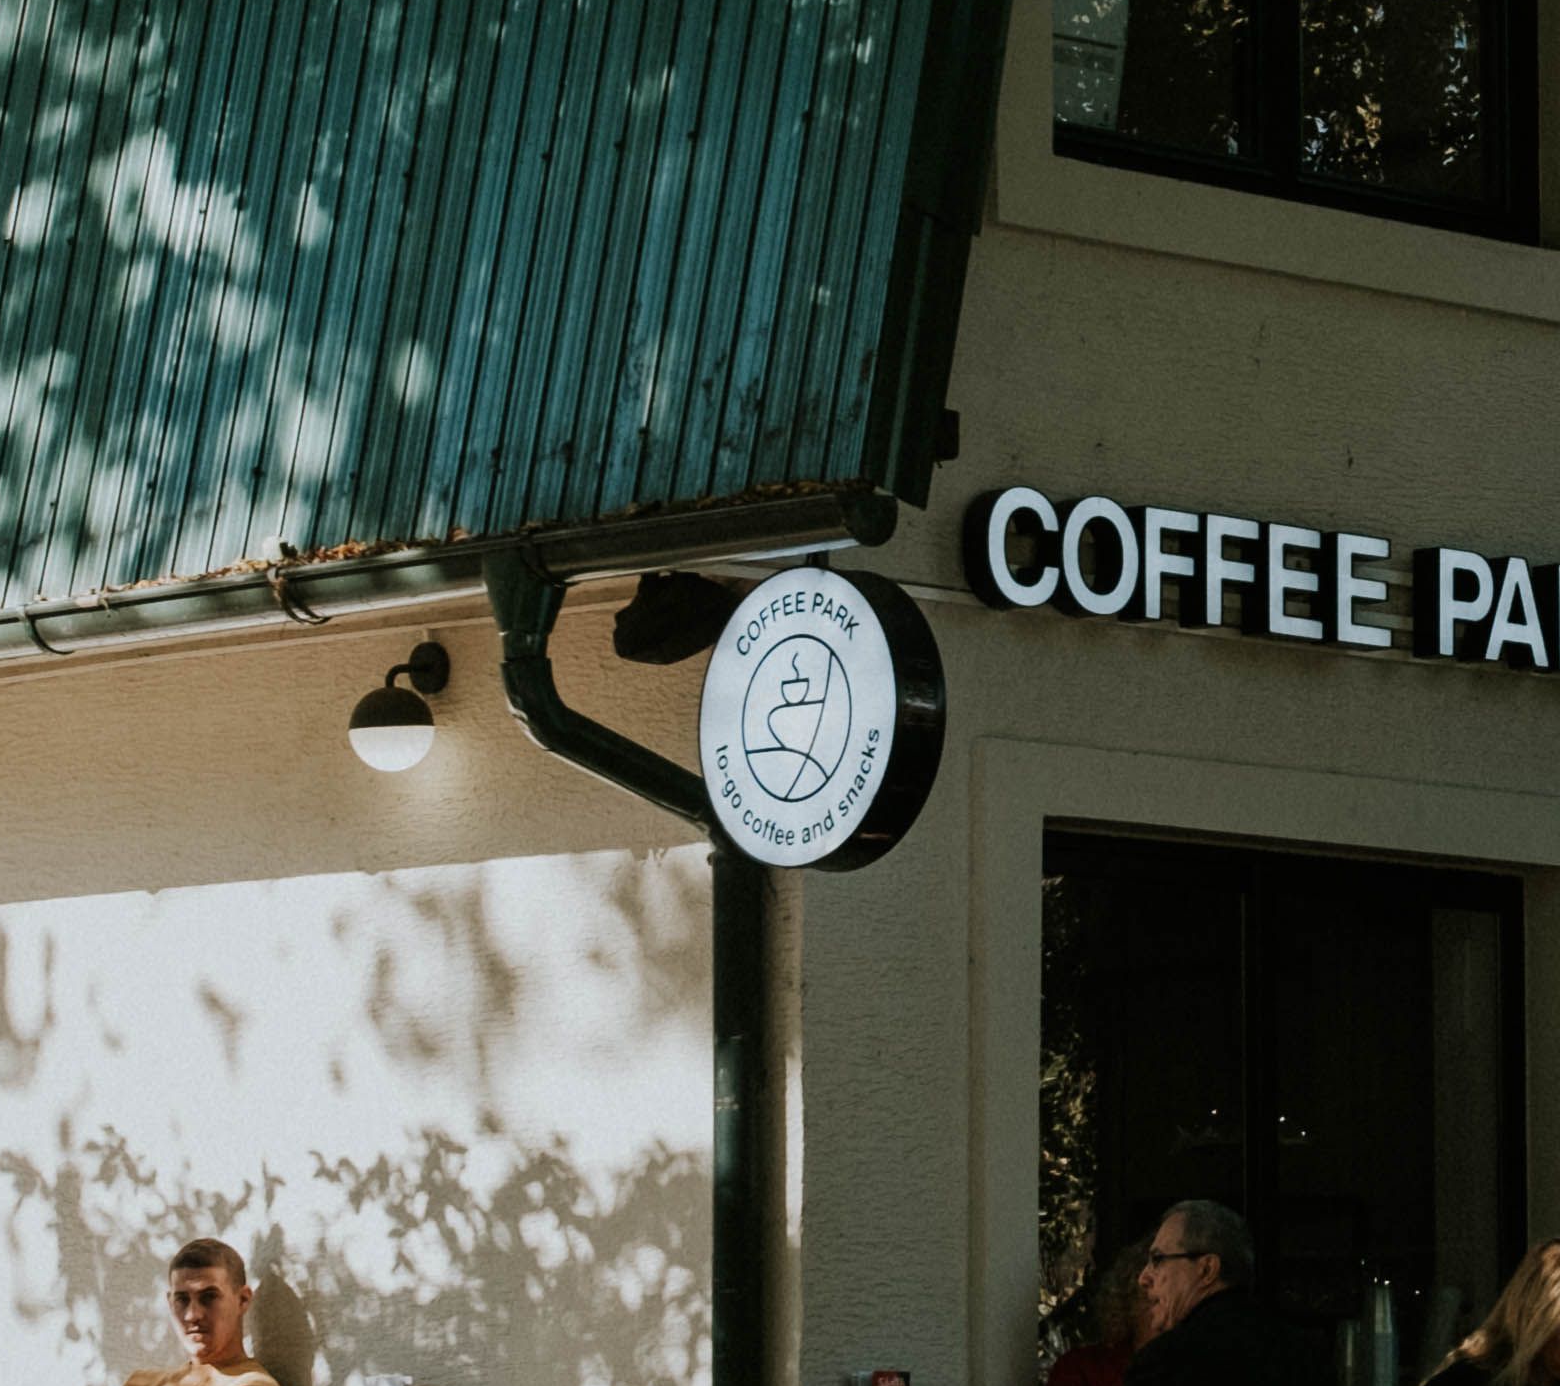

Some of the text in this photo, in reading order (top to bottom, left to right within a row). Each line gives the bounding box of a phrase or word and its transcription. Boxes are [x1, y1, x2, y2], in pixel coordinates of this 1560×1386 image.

[736, 591, 860, 656] COFFEE PARK
[987, 486, 1392, 648] COFFEE
[743, 809, 795, 846] coffee
[802, 812, 835, 845] and
[838, 727, 880, 818] snacks
